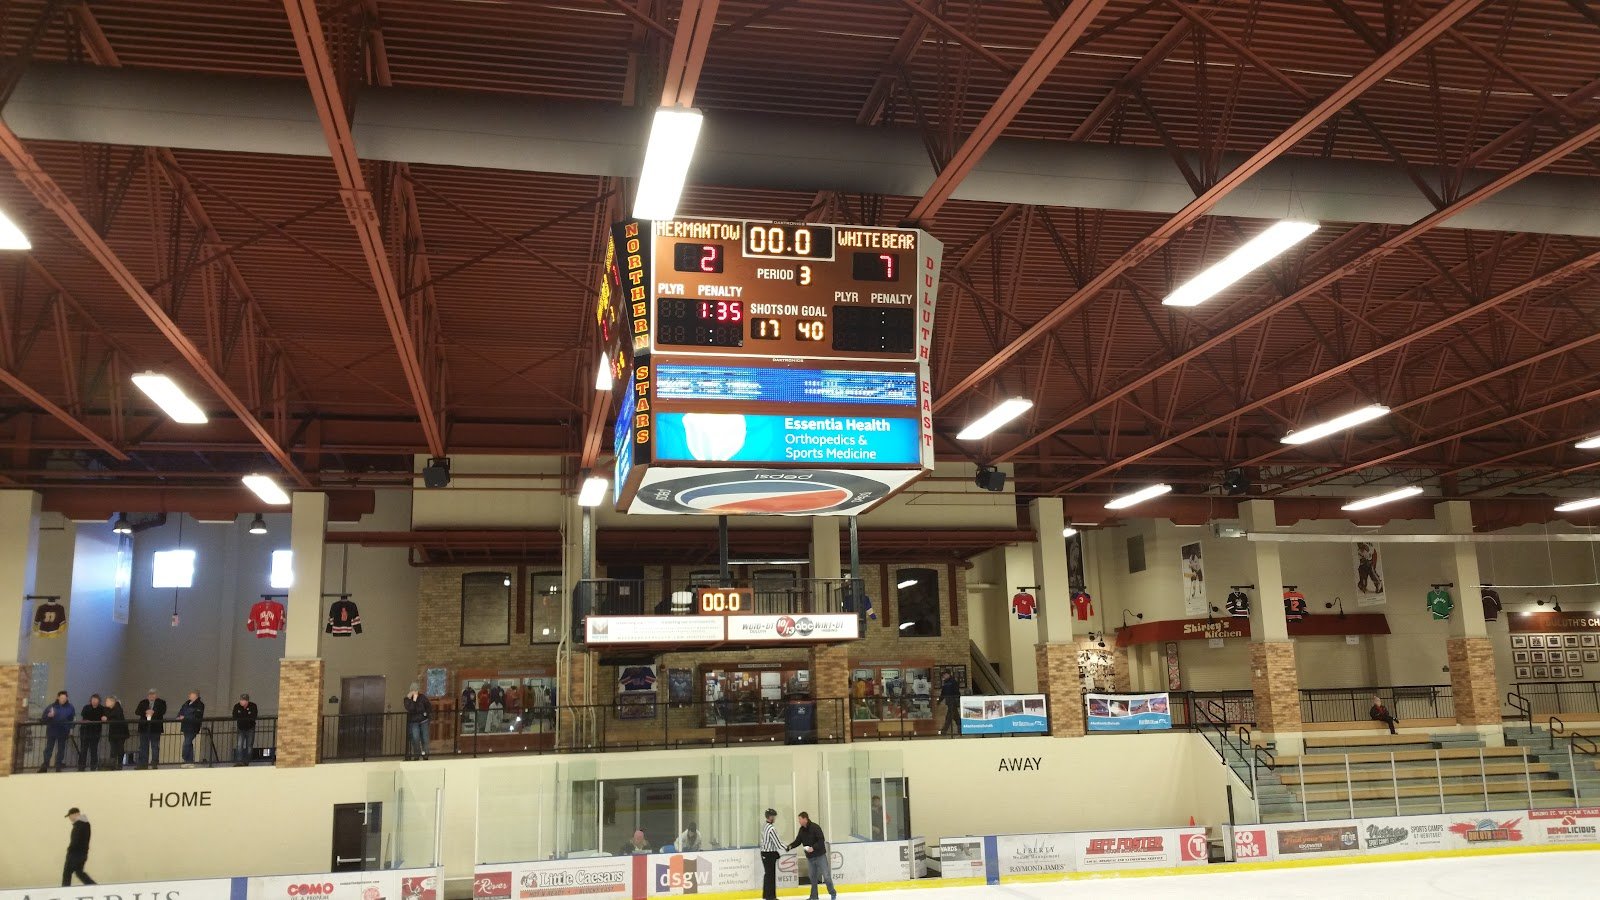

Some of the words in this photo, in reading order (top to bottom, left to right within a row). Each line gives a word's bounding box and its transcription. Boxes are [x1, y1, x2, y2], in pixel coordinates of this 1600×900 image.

[750, 226, 810, 255] 00.0
[701, 246, 716, 271] 2
[879, 254, 892, 278] 7
[757, 268, 794, 280] PERIOD
[800, 265, 811, 285] 3
[625, 222, 649, 350] NORTHERN
[658, 283, 685, 295] PLYR
[698, 284, 743, 297] PENALTY
[834, 291, 859, 303] PLYR
[871, 293, 912, 305] PENALTY
[702, 301, 740, 321] 1:35
[750, 303, 783, 315] SHOTS
[785, 304, 798, 316] ON
[801, 305, 827, 317] GOAL
[919, 256, 934, 360] DULUTH
[760, 320, 779, 337] 17
[799, 321, 824, 341] 40
[636, 366, 650, 444] STARS
[922, 380, 933, 447] EAST
[784, 417, 844, 431] Essentia
[846, 418, 891, 432] Health
[785, 433, 856, 447] Orthopedics
[858, 434, 868, 445] &
[785, 447, 824, 460] Sports
[826, 447, 877, 459] Medicine
[702, 592, 740, 611] 00.0
[795, 621, 815, 631] abc
[1204, 630, 1242, 639] Kitchen
[998, 757, 1042, 772] AWAY
[149, 791, 212, 808] HOME
[1428, 824, 1444, 832] CAMPS
[1089, 839, 1116, 853] JEFF
[1117, 836, 1164, 851] FOSTER
[1009, 865, 1043, 873] RAYMOND
[539, 870, 575, 888] Little
[575, 869, 625, 887] Caesars
[660, 868, 709, 889] dsgw
[287, 882, 334, 897] COMO
